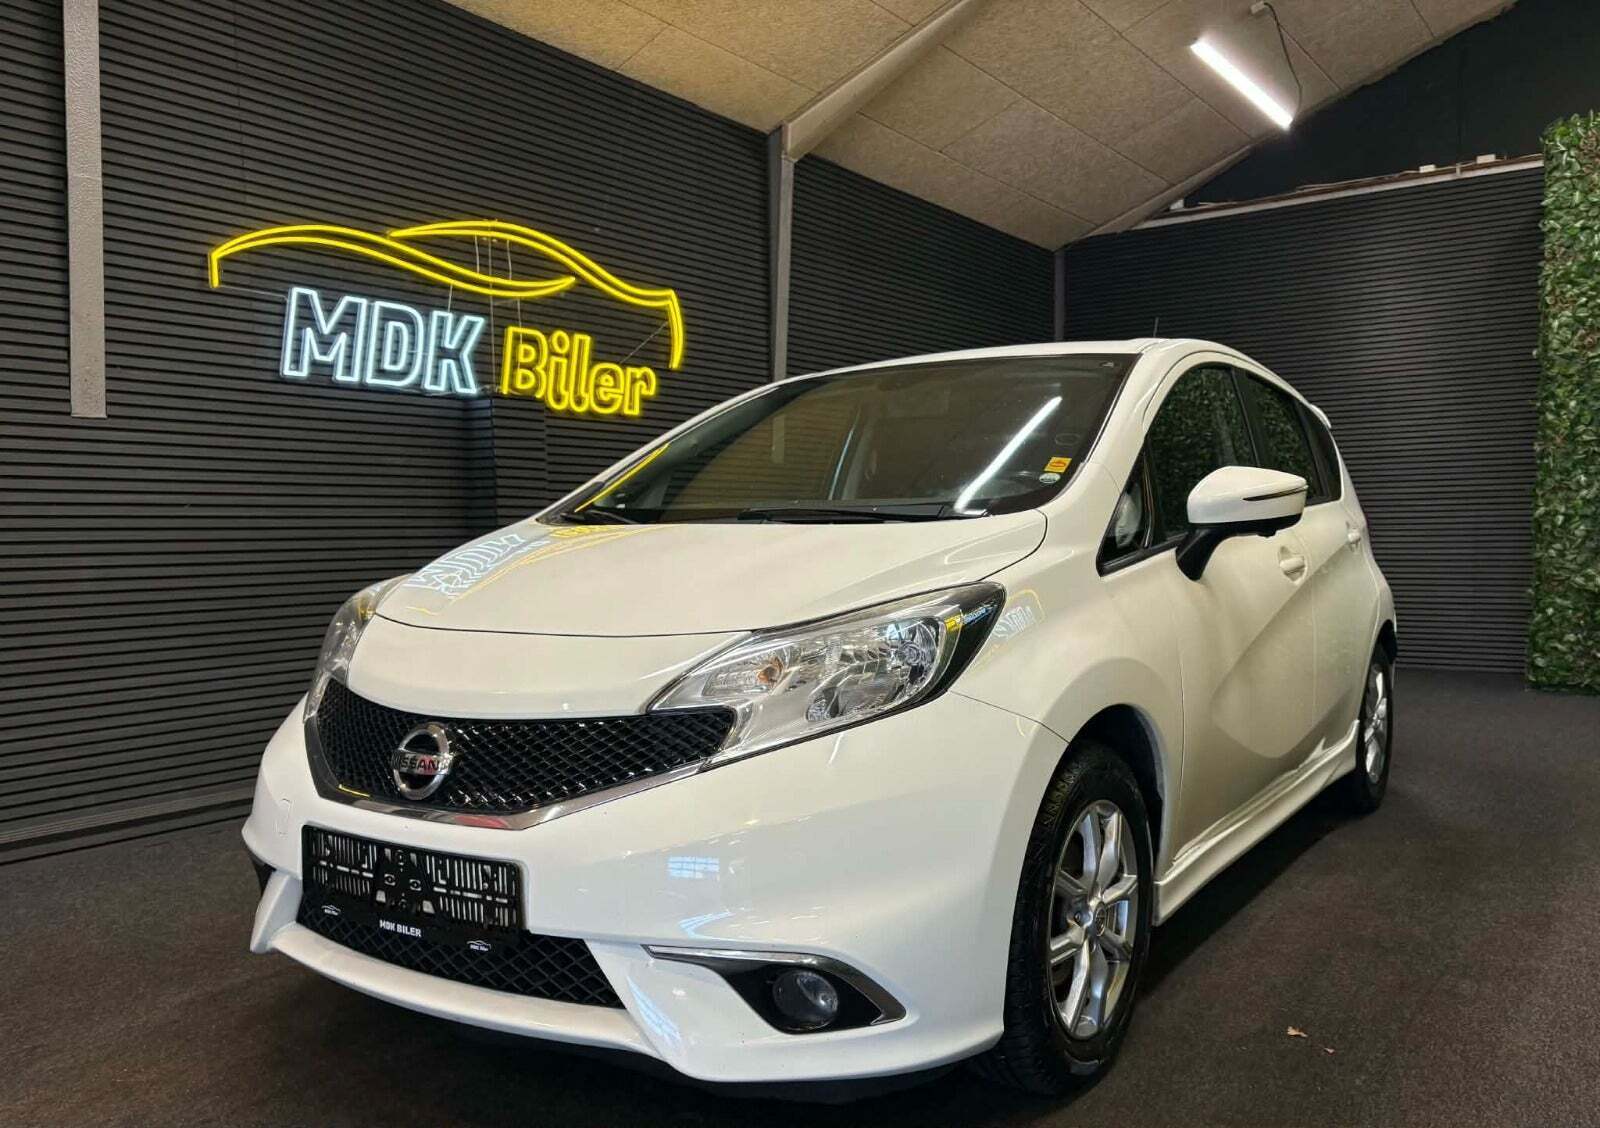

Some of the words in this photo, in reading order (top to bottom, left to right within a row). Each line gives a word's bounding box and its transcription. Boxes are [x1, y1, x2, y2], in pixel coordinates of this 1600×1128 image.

[282, 287, 485, 395] MDK
[502, 326, 655, 415] Biler
[391, 754, 440, 772] SSAN
[379, 919, 396, 931] MDK
[396, 923, 422, 938] BILER
